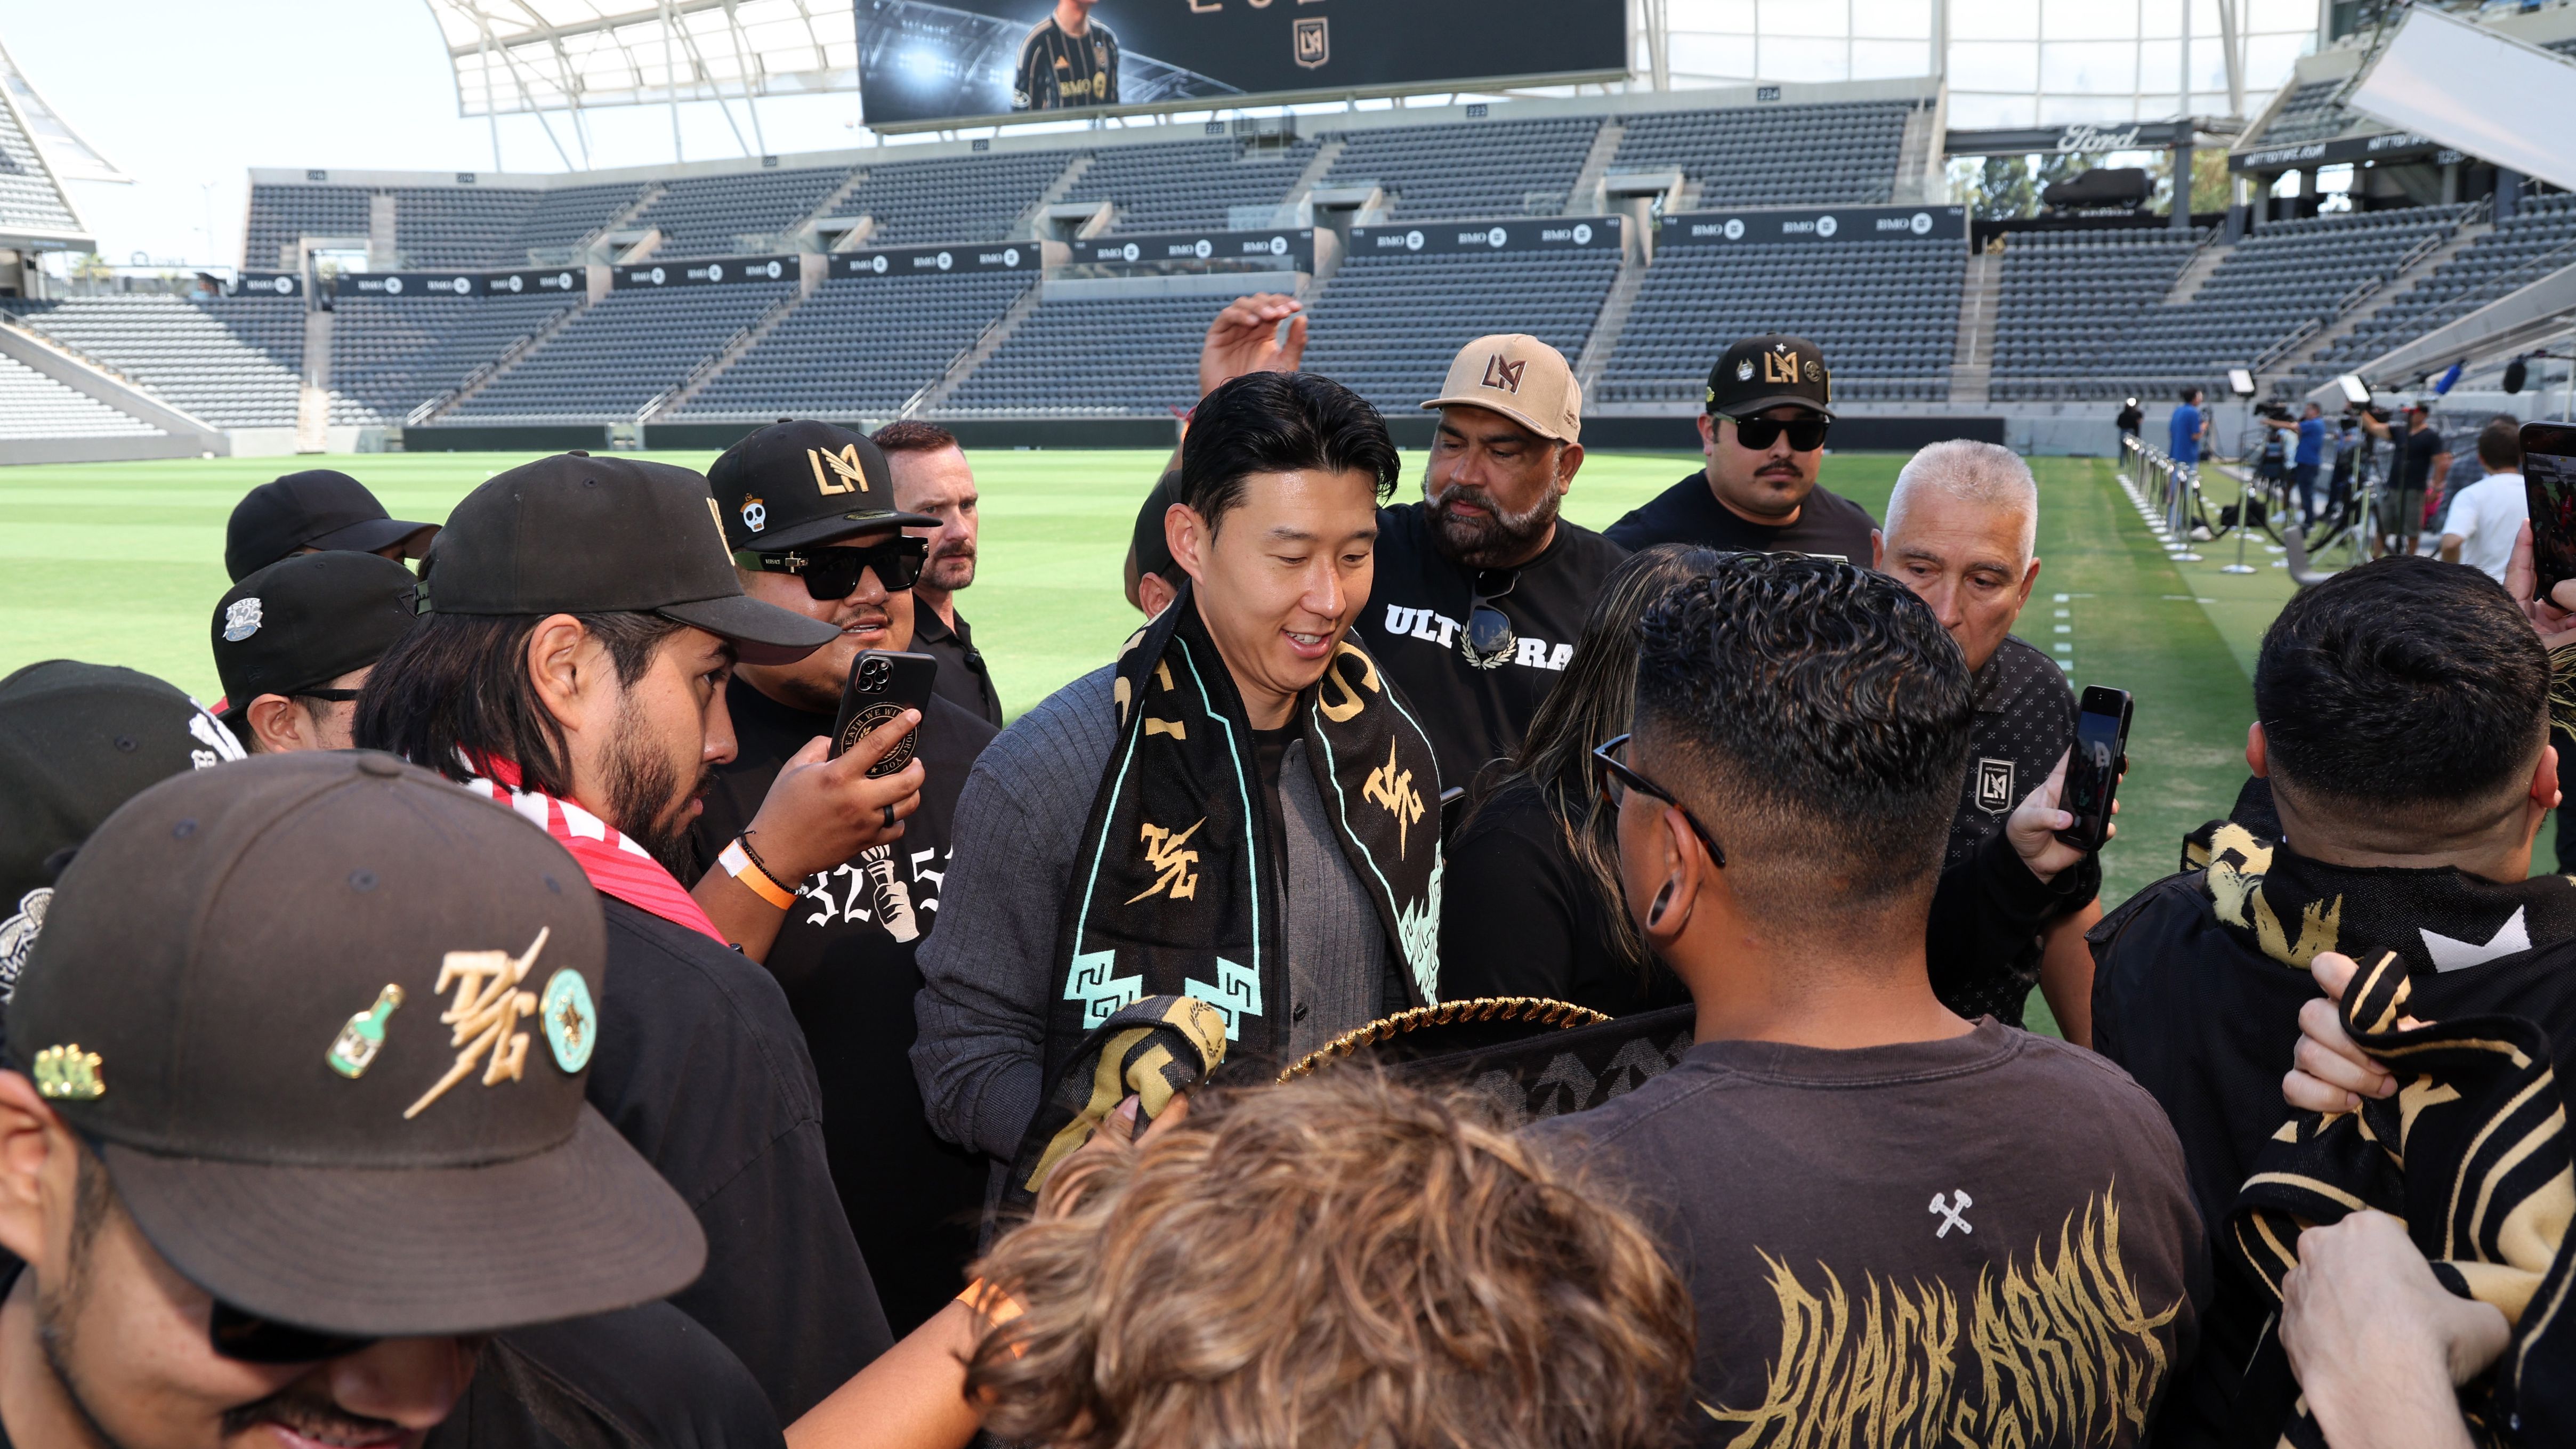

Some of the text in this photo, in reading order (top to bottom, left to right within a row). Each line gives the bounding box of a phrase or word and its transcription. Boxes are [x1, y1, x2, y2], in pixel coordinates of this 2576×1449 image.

[2057, 123, 2141, 153] Ford
[1692, 218, 1909, 236] BMO BMO BMO
[1377, 230, 1570, 247] BMO BMO BMO
[1098, 242, 1269, 258] BMO BMO BMO
[914, 257, 936, 267] BMO
[980, 254, 1003, 264] BMO
[866, 709, 880, 719] WE
[883, 758, 902, 772] YOU
[1970, 1172, 2185, 1448] ARMY
